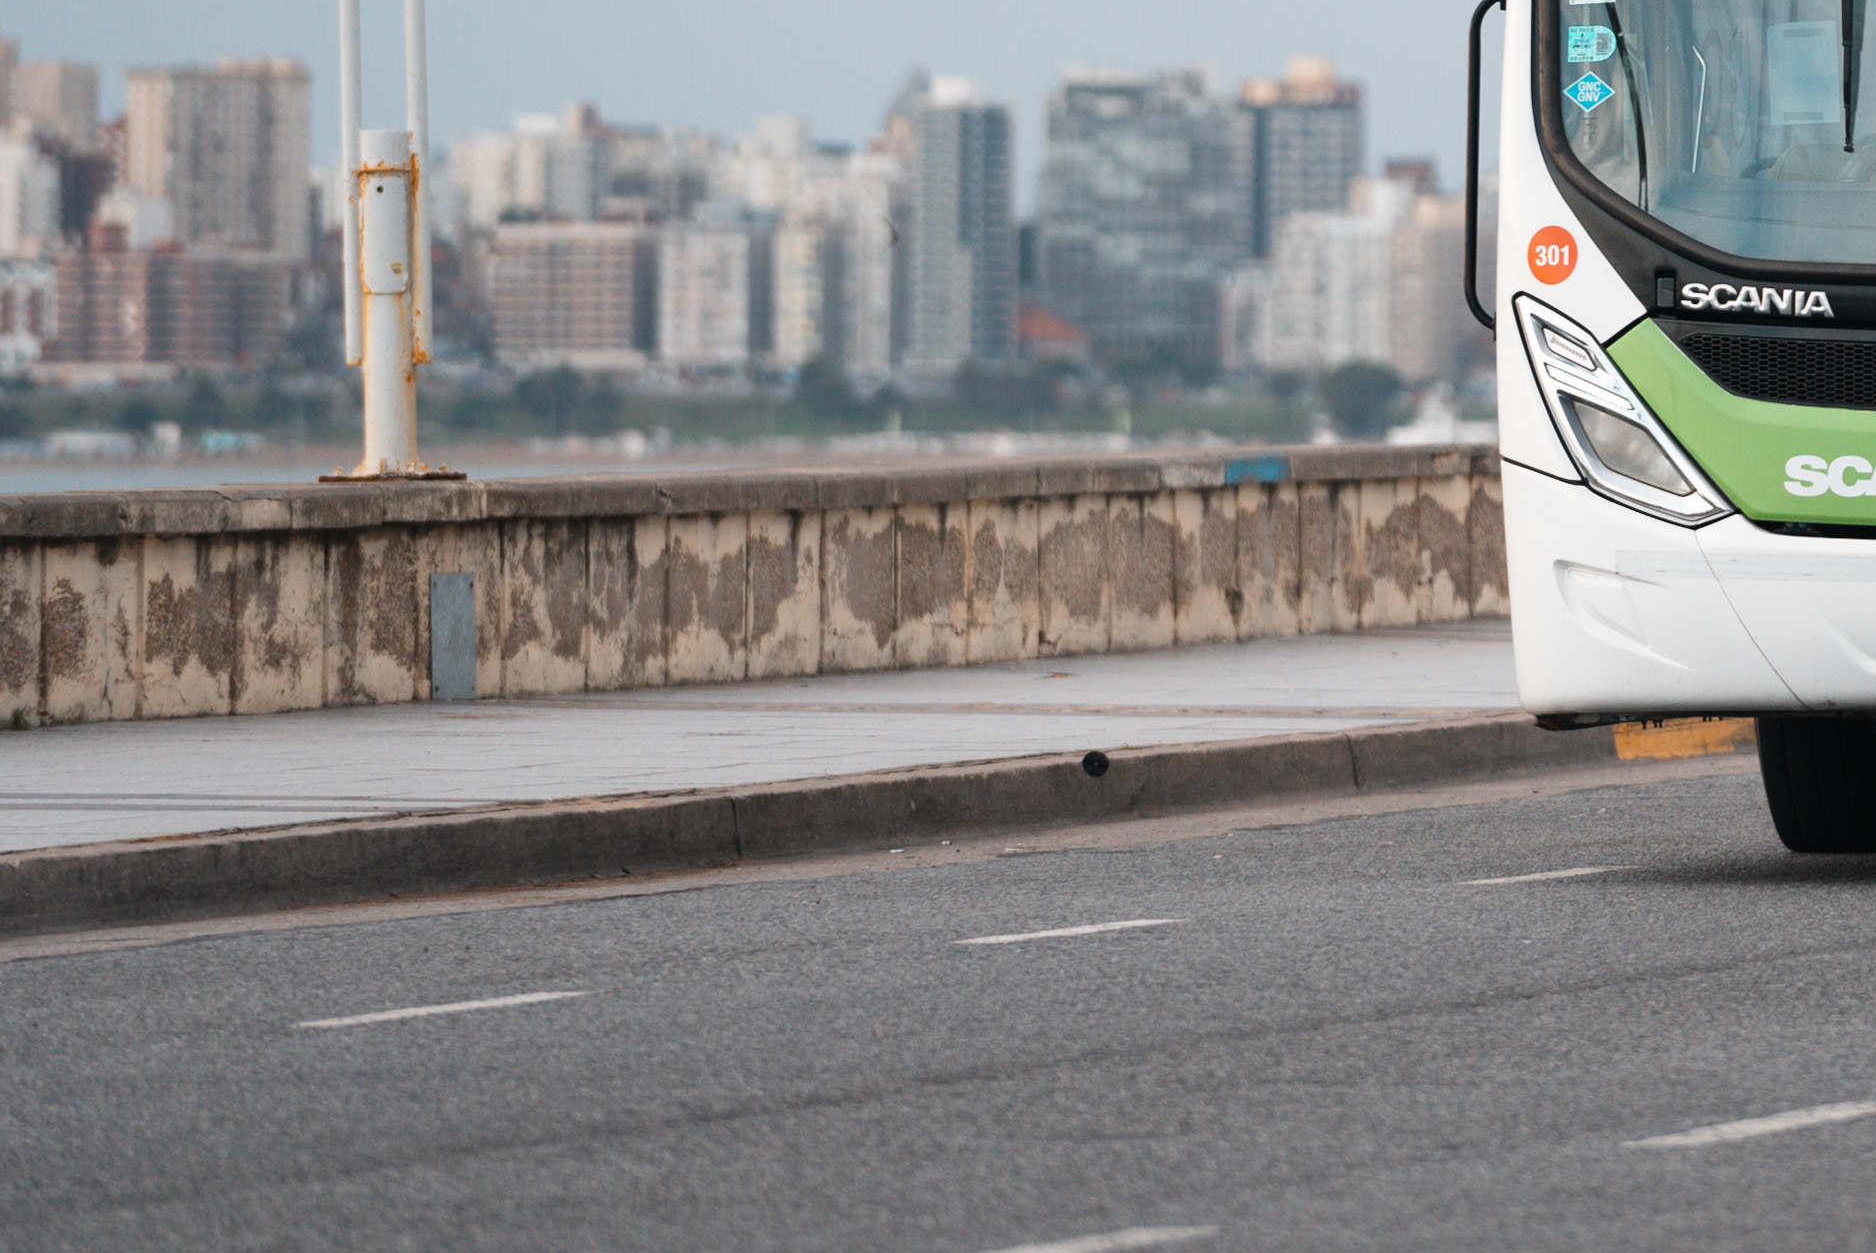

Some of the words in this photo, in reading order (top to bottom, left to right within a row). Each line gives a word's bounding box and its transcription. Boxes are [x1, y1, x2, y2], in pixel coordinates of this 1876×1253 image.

[1577, 81, 1602, 92] GNC
[1577, 91, 1601, 102] GNV
[1535, 244, 1570, 267] 301
[1681, 282, 1835, 318] SCANIA
